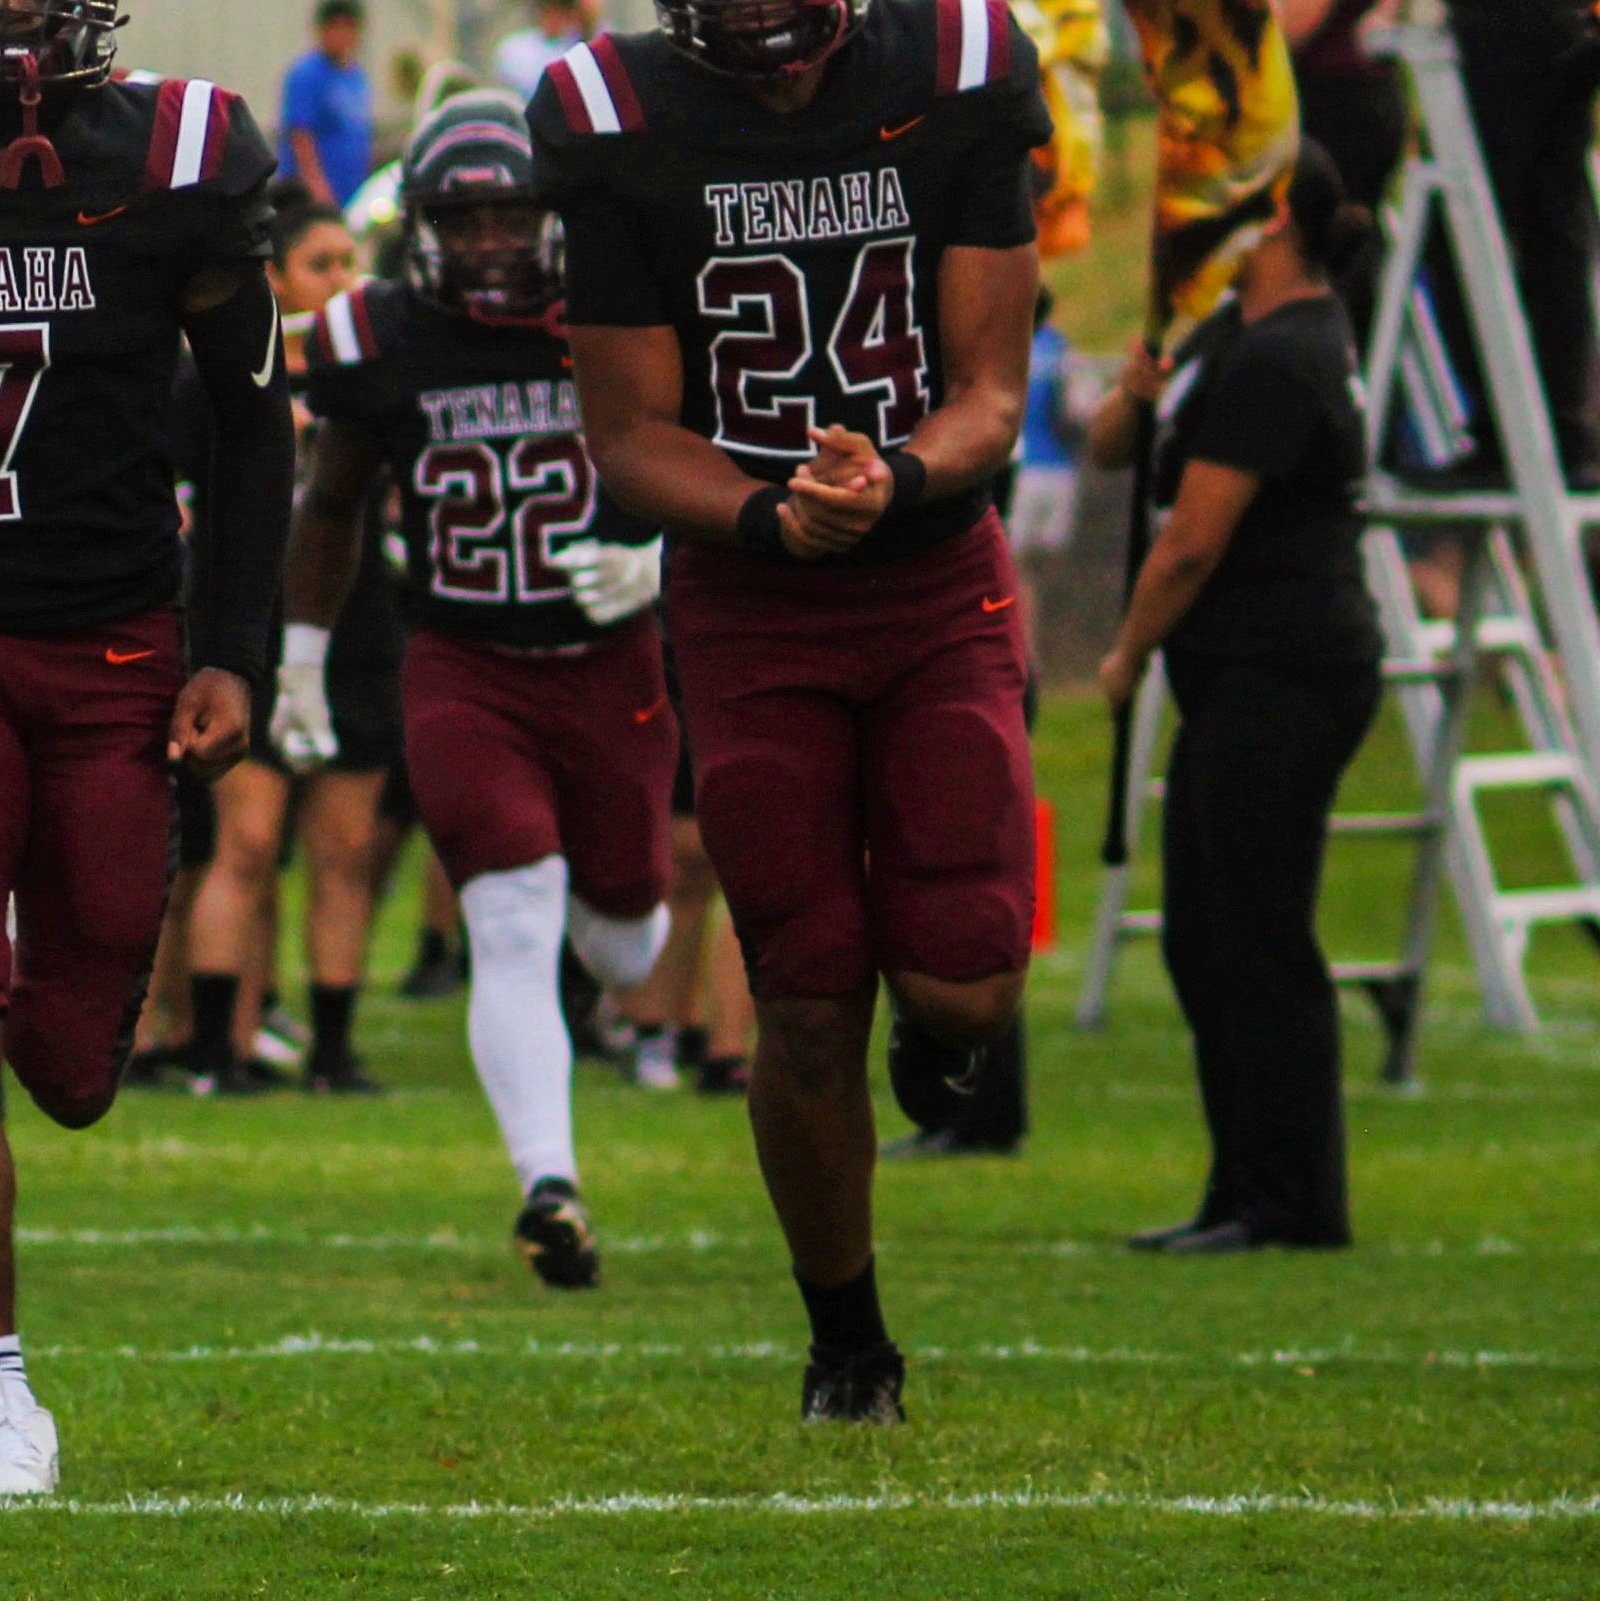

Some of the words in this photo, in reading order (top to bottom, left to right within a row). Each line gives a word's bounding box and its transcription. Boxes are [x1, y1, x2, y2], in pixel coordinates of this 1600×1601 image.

[705, 167, 910, 246] TENAHA
[696, 236, 930, 459] 24
[415, 436, 599, 603] 22
